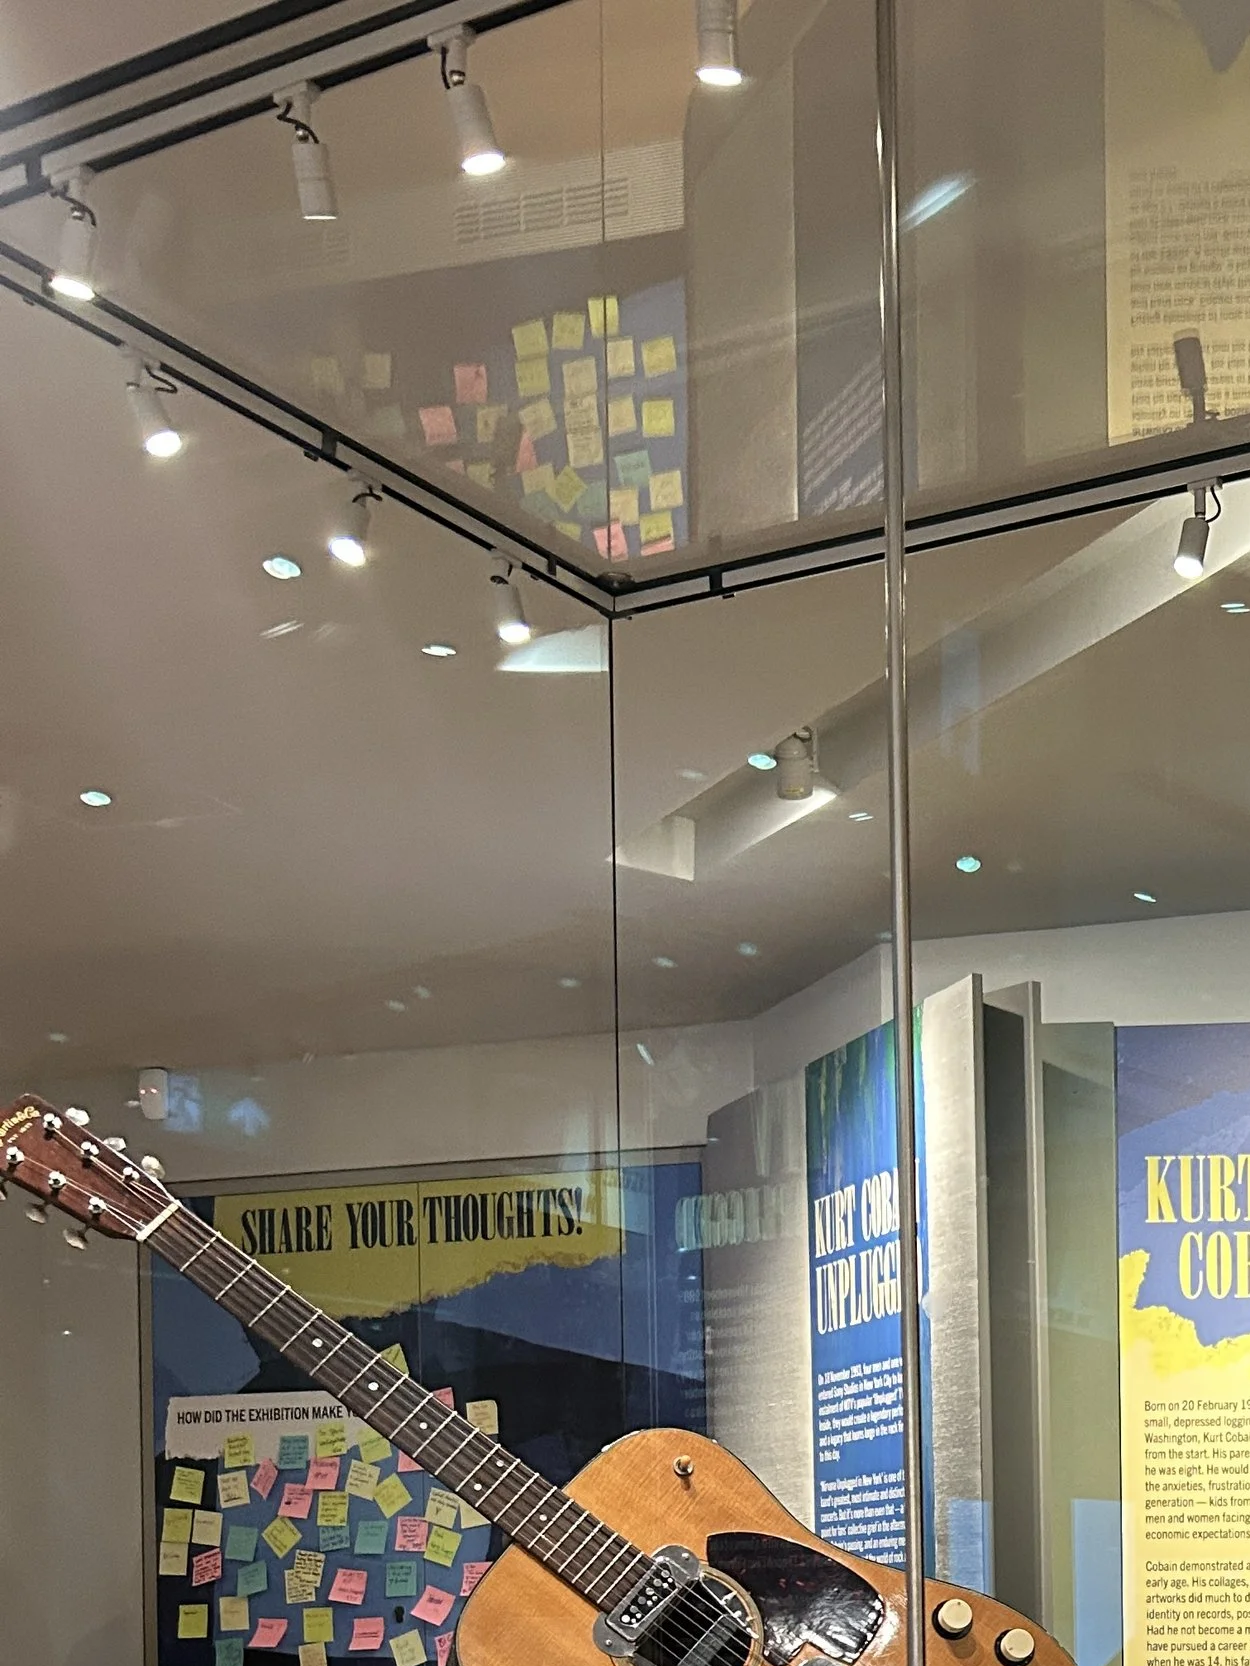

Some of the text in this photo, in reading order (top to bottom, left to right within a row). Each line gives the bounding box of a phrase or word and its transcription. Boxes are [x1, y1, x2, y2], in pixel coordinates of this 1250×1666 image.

[241, 1186, 583, 1257] SHARE YOUR THOUGHTS!
[814, 1184, 856, 1258] KURT
[815, 1237, 922, 1335] UNPLUGG
[177, 1410, 201, 1424] HOW
[204, 1409, 222, 1424] DID
[225, 1408, 246, 1422] THE
[249, 1406, 309, 1421] EXHIBITION
[312, 1405, 344, 1419] MAKE
[1144, 1400, 1166, 1411] Born
[1167, 1402, 1179, 1411] on
[1181, 1399, 1194, 1410] 20
[1197, 1399, 1237, 1412] February
[1173, 1415, 1221, 1429] depressed
[1203, 1431, 1223, 1442] Kurt
